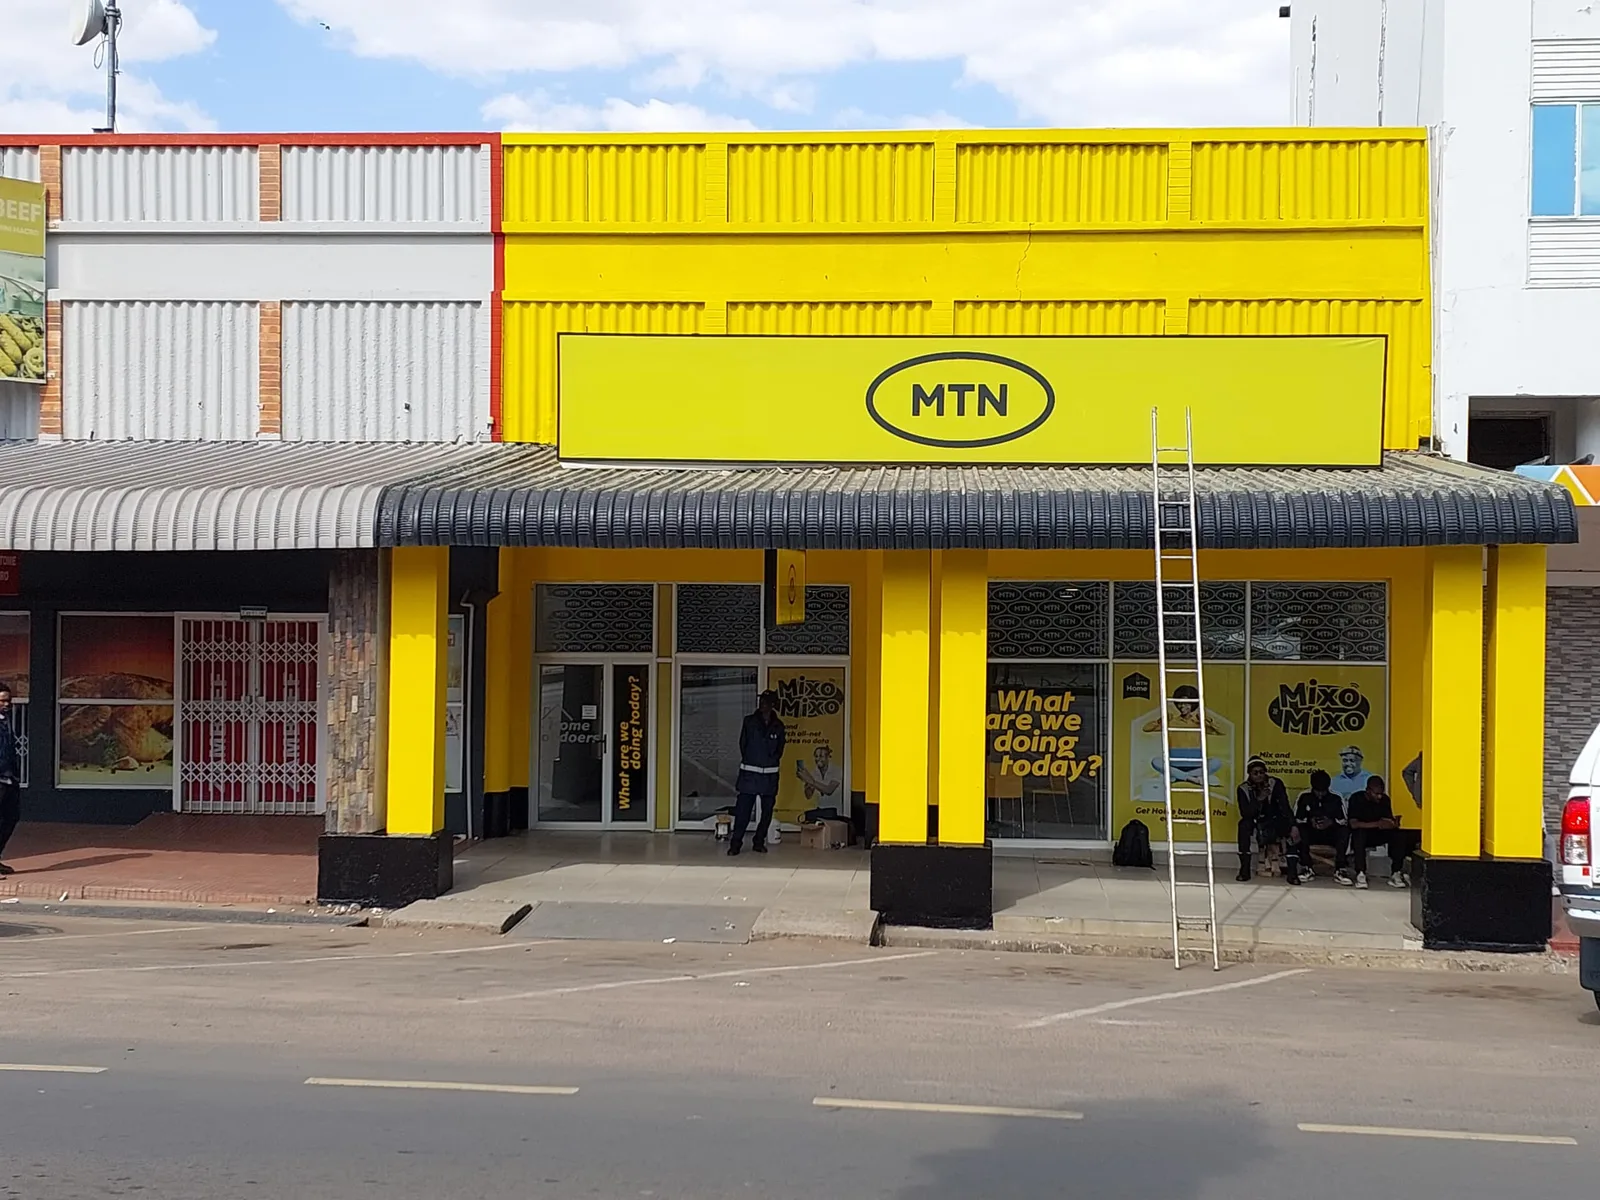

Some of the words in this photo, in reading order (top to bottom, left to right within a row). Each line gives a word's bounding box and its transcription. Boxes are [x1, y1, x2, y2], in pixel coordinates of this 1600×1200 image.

[912, 384, 1008, 417] MTN
[628, 676, 642, 726] today?
[778, 676, 836, 698] Mixo
[998, 689, 1076, 712] What
[1280, 678, 1360, 708] Mixo
[780, 696, 840, 718] Mixo
[620, 721, 630, 742] we
[986, 714, 1034, 730] are
[1040, 714, 1082, 732] we
[1282, 708, 1366, 736] Mixo
[620, 744, 630, 770] are
[630, 728, 643, 770] doing
[994, 728, 1080, 759] doing
[1000, 754, 1103, 782] today?
[619, 772, 630, 810] What
